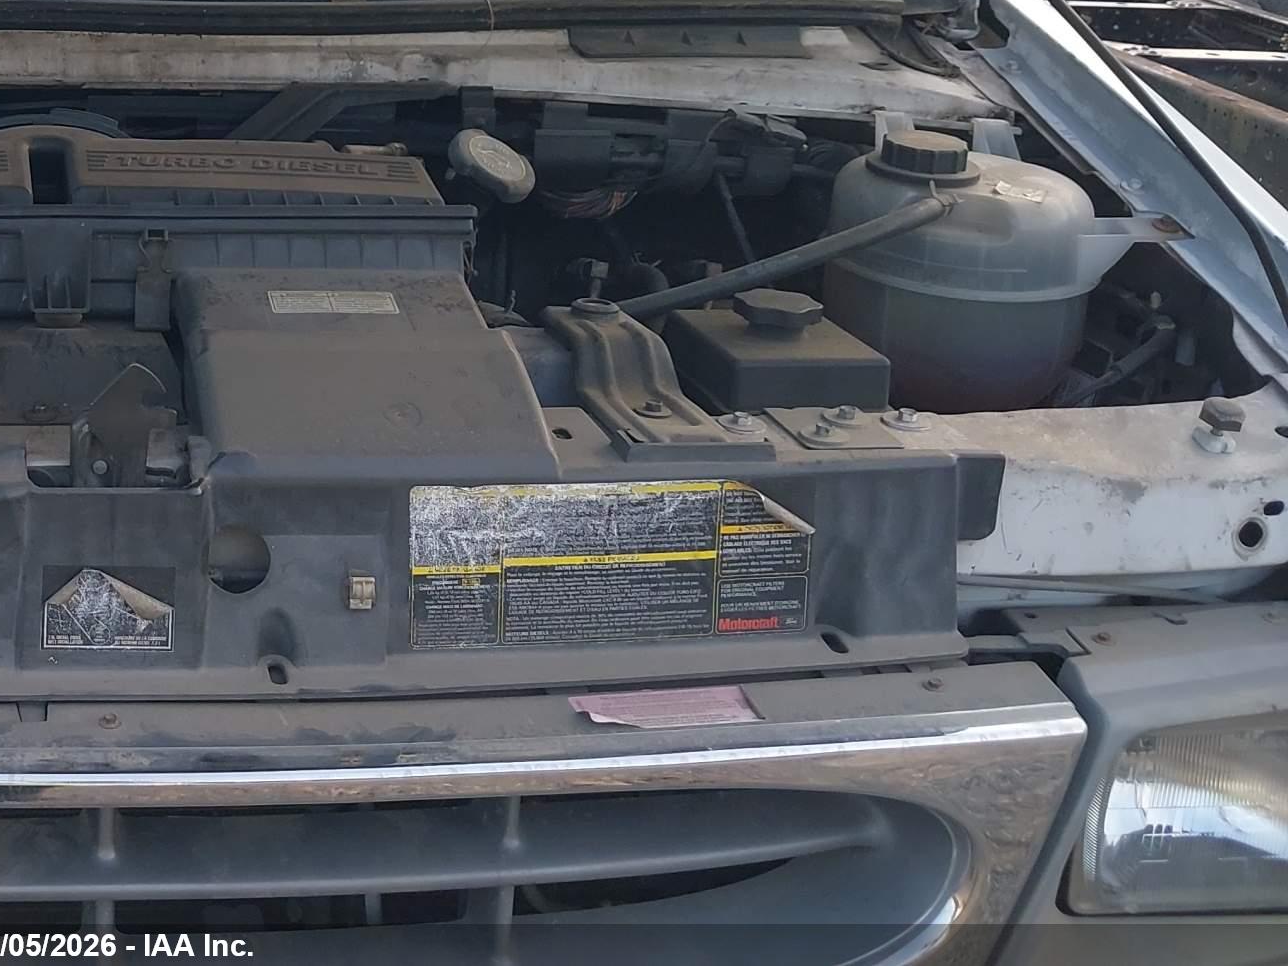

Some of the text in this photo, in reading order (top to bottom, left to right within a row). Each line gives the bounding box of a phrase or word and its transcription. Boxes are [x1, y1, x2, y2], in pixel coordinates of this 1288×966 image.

[115, 152, 379, 177] TURBO DIESEL
[719, 617, 778, 631] Motorcraft
